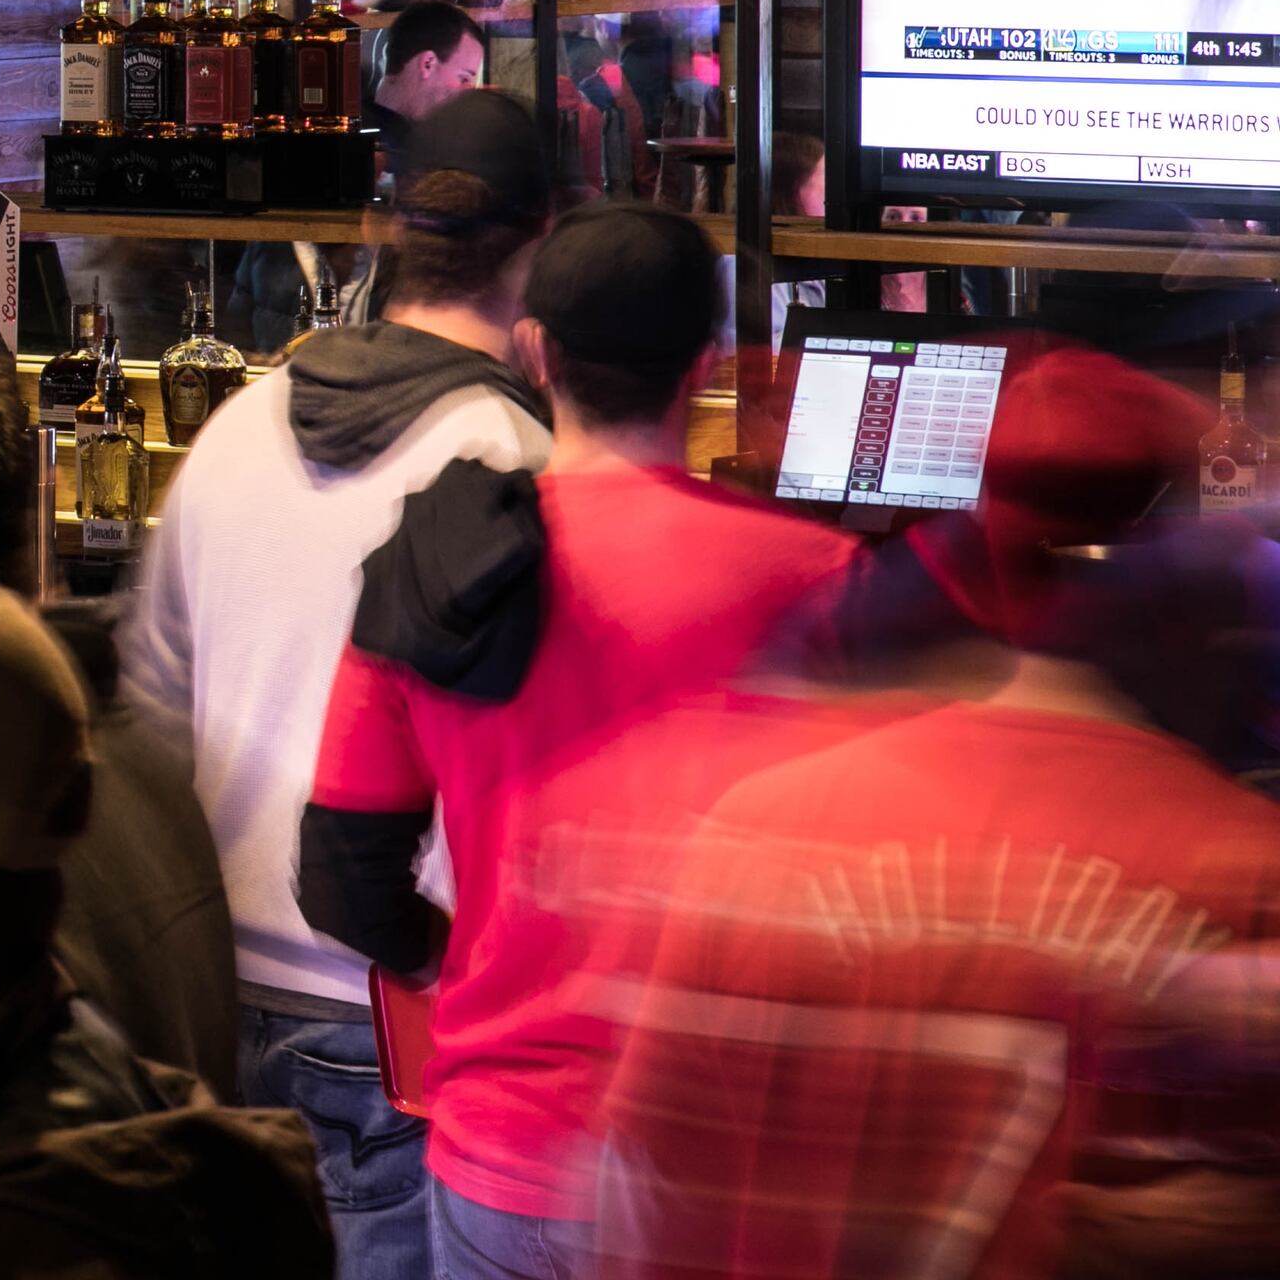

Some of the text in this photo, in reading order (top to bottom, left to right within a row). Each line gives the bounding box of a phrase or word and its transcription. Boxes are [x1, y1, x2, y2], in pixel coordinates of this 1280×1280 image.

[947, 28, 991, 46] UTAH
[1000, 30, 1036, 48] 102
[1088, 31, 1119, 50] GS
[1154, 33, 1179, 51] 111
[909, 49, 974, 60] TIMEOUTS: 3
[999, 51, 1037, 62] BONUS
[1049, 51, 1116, 63] TIMEOUTS: 3
[1192, 40, 1262, 58] 4th 1:45
[1141, 54, 1179, 65] BONUS
[976, 106, 1270, 133] COULD YOU SEE THE WARRIORS
[901, 152, 990, 171] NBA EAST
[1006, 158, 1047, 174] BOS
[1146, 162, 1192, 179] WSH
[2, 213, 17, 324] Coors LIGHT
[88, 526, 123, 542] Jimador
